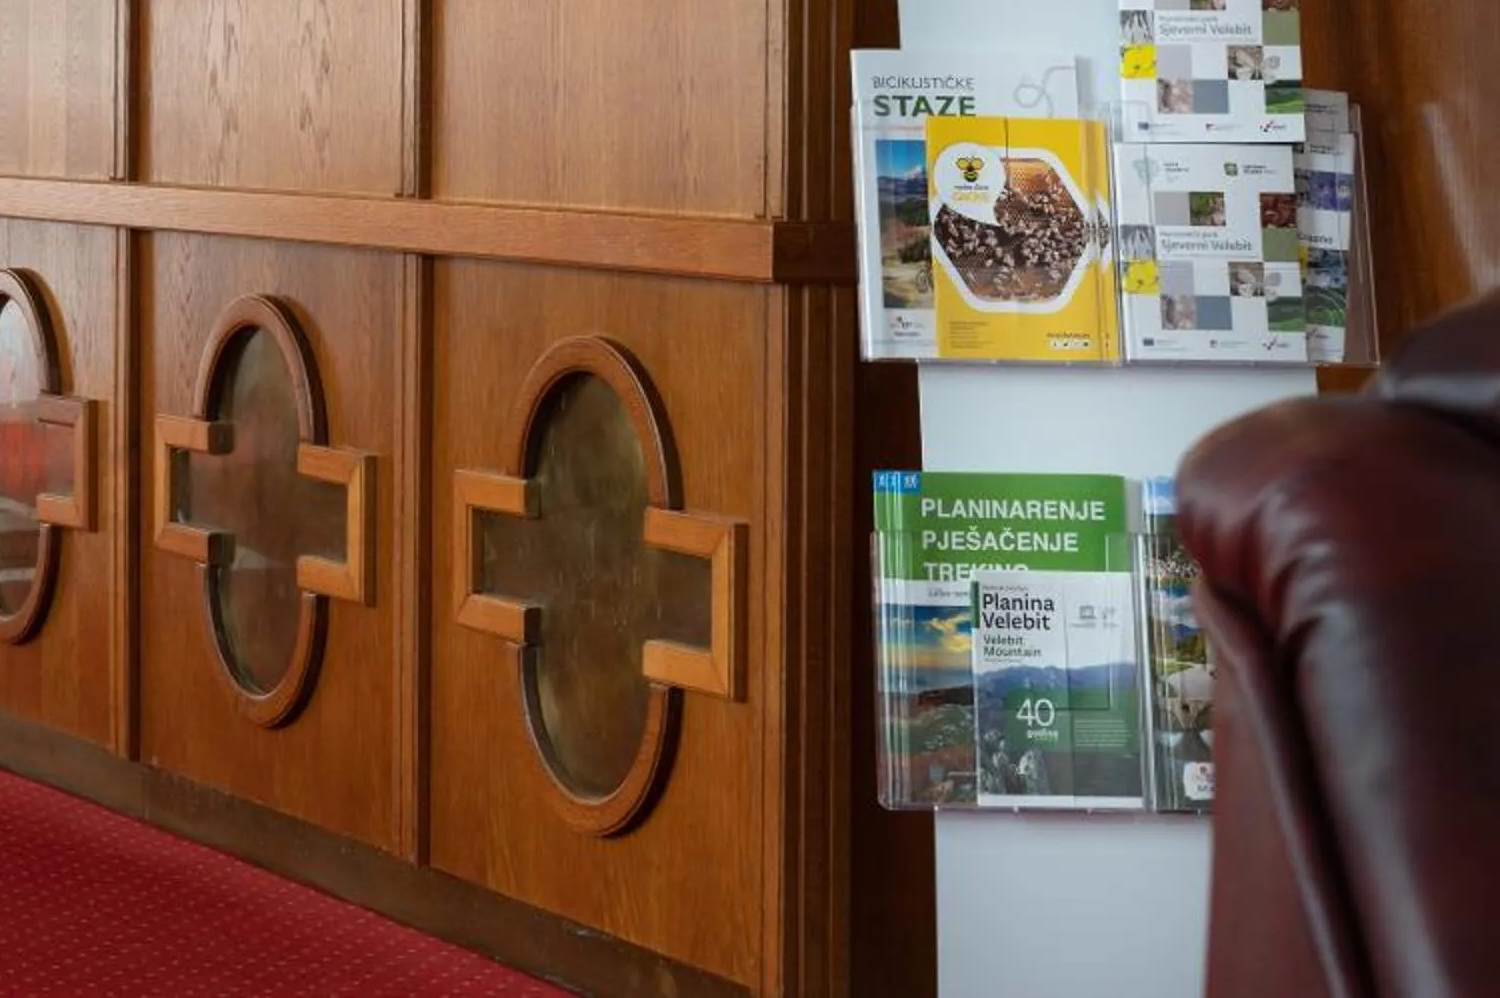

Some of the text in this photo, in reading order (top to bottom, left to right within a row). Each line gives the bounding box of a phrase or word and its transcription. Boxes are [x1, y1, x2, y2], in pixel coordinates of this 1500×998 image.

[873, 95, 976, 117] STAZE
[921, 498, 1106, 520] PLANINARENJE
[922, 526, 1079, 552] PJEŠAČENJE
[982, 593, 1055, 611] Planina
[982, 612, 1051, 631] Velebit
[983, 634, 1024, 646] Velebit
[983, 647, 1041, 657] Mountain
[1016, 698, 1055, 727] 40
